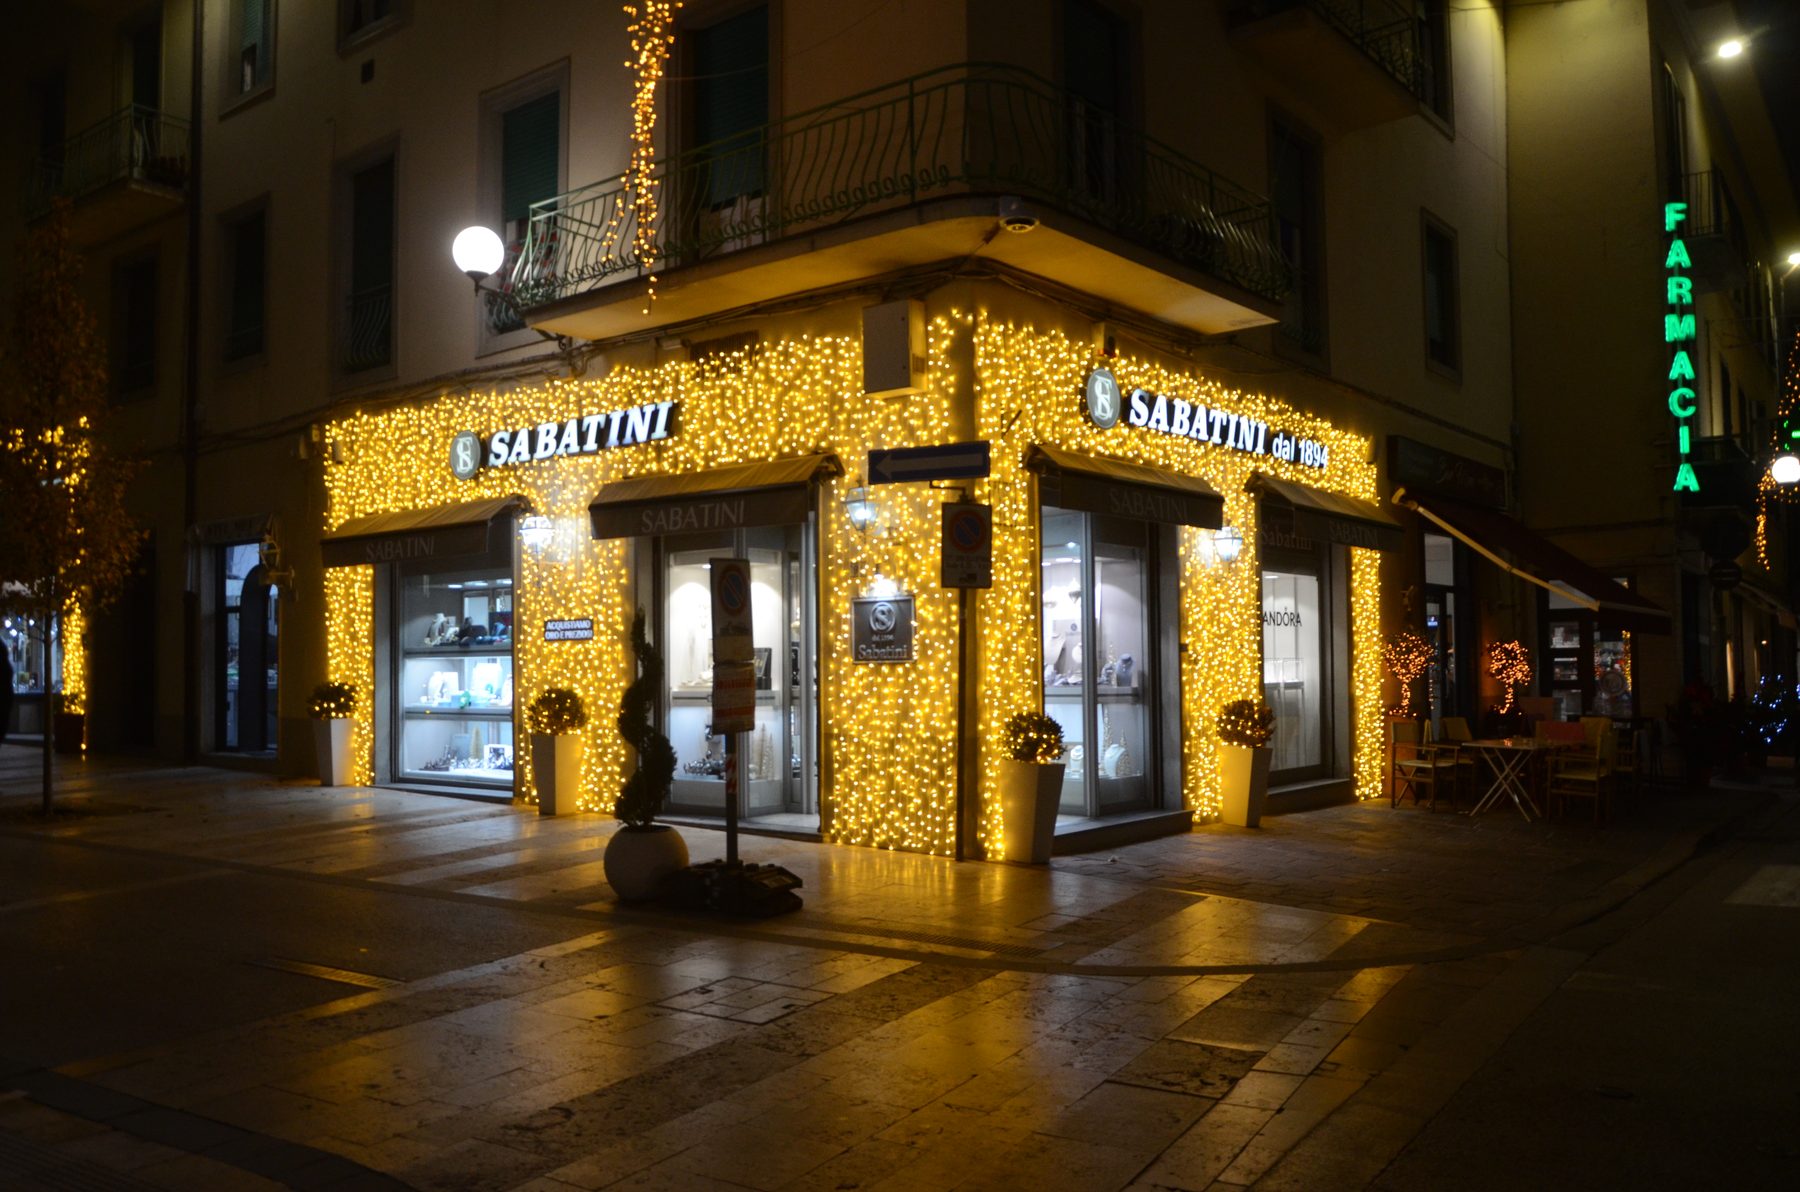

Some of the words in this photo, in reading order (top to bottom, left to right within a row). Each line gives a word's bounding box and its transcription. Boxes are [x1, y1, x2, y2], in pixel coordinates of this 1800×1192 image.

[1664, 202, 1700, 492] FARMACIA
[488, 401, 673, 467] SABATINI
[1129, 388, 1268, 455] SABATINI
[1272, 431, 1296, 462] dal
[1298, 438, 1329, 470] 1894
[641, 499, 745, 534] SABATINI
[1109, 487, 1188, 520] SABATINI
[365, 535, 435, 561] SABATINI
[1328, 519, 1379, 545] SABATINI
[1262, 610, 1303, 627] ANDORA
[858, 643, 908, 660] Sabatini
